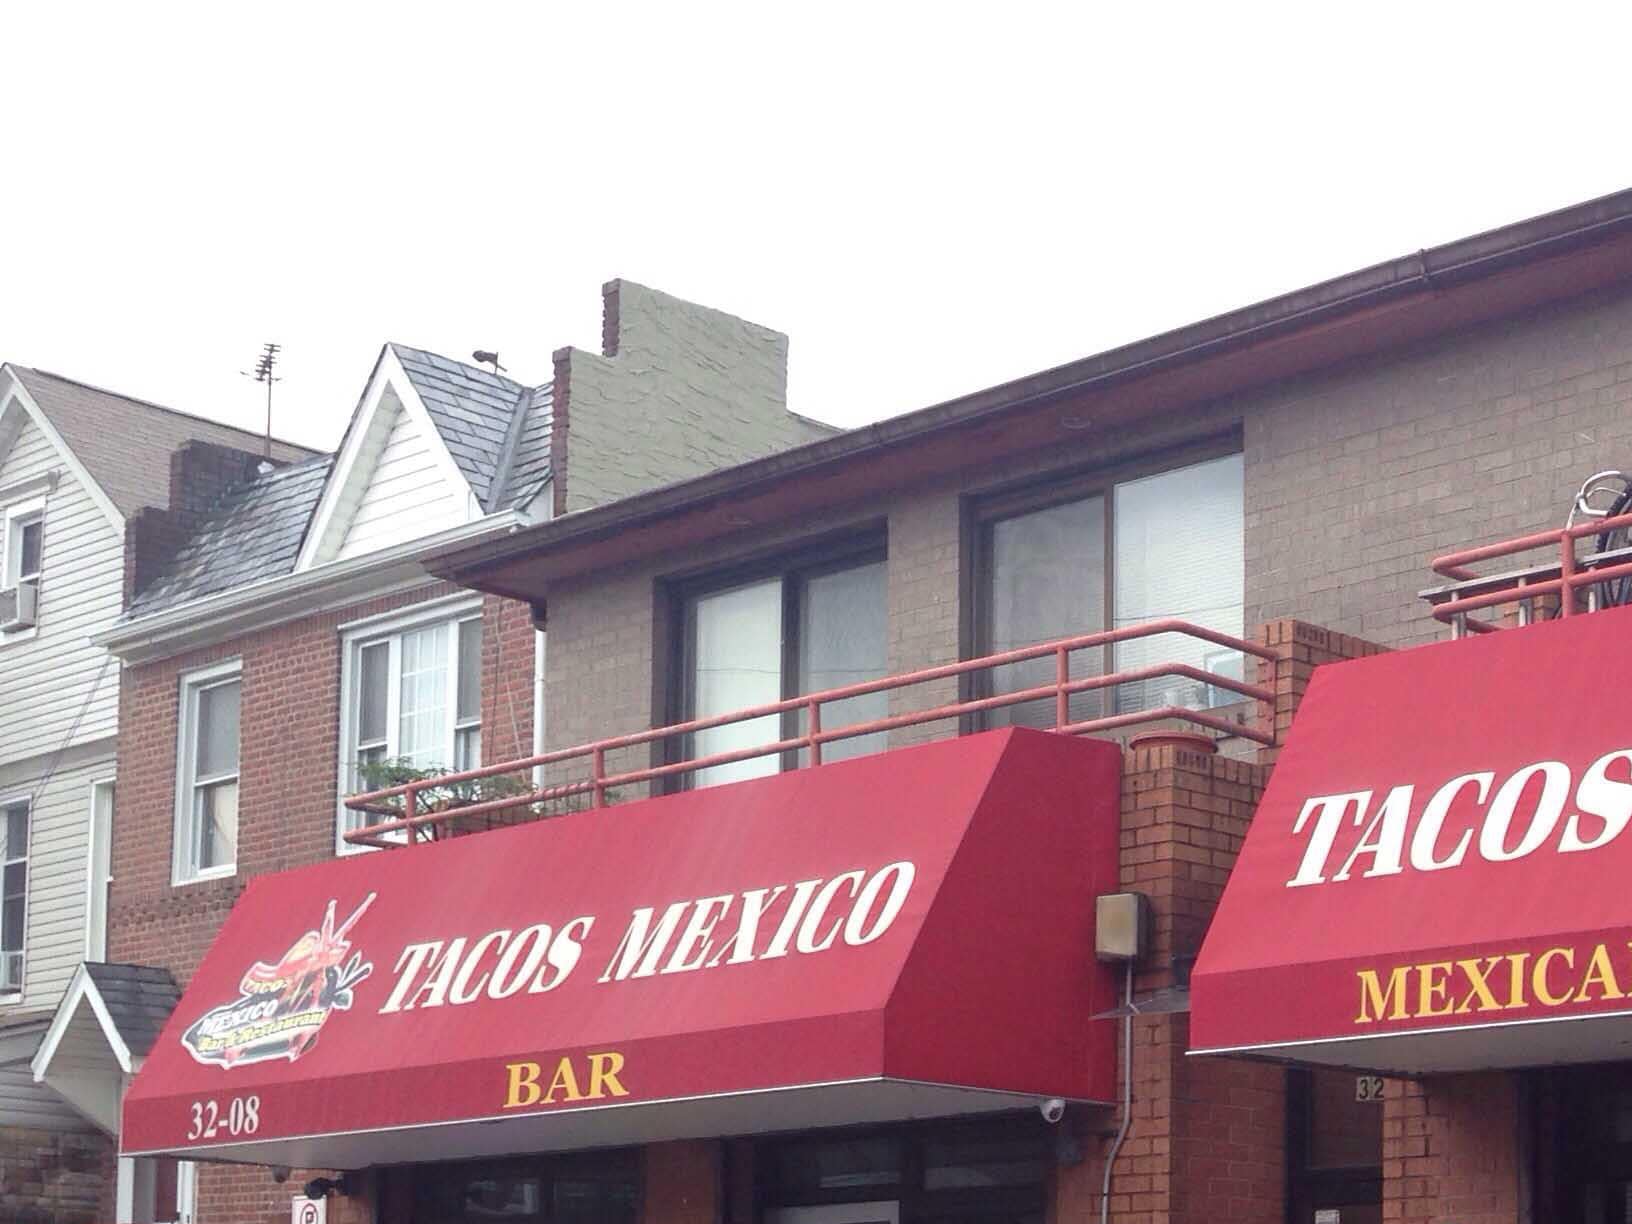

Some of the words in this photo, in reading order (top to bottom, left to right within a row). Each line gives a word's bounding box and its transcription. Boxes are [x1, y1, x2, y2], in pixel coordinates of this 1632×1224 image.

[378, 914, 596, 1014] TACOS
[598, 860, 916, 984] MEXICO
[197, 999, 279, 1036] MEXICO
[503, 1051, 630, 1108] BAR
[1359, 1078, 1385, 1100] 32
[187, 1095, 260, 1141] 32-08
